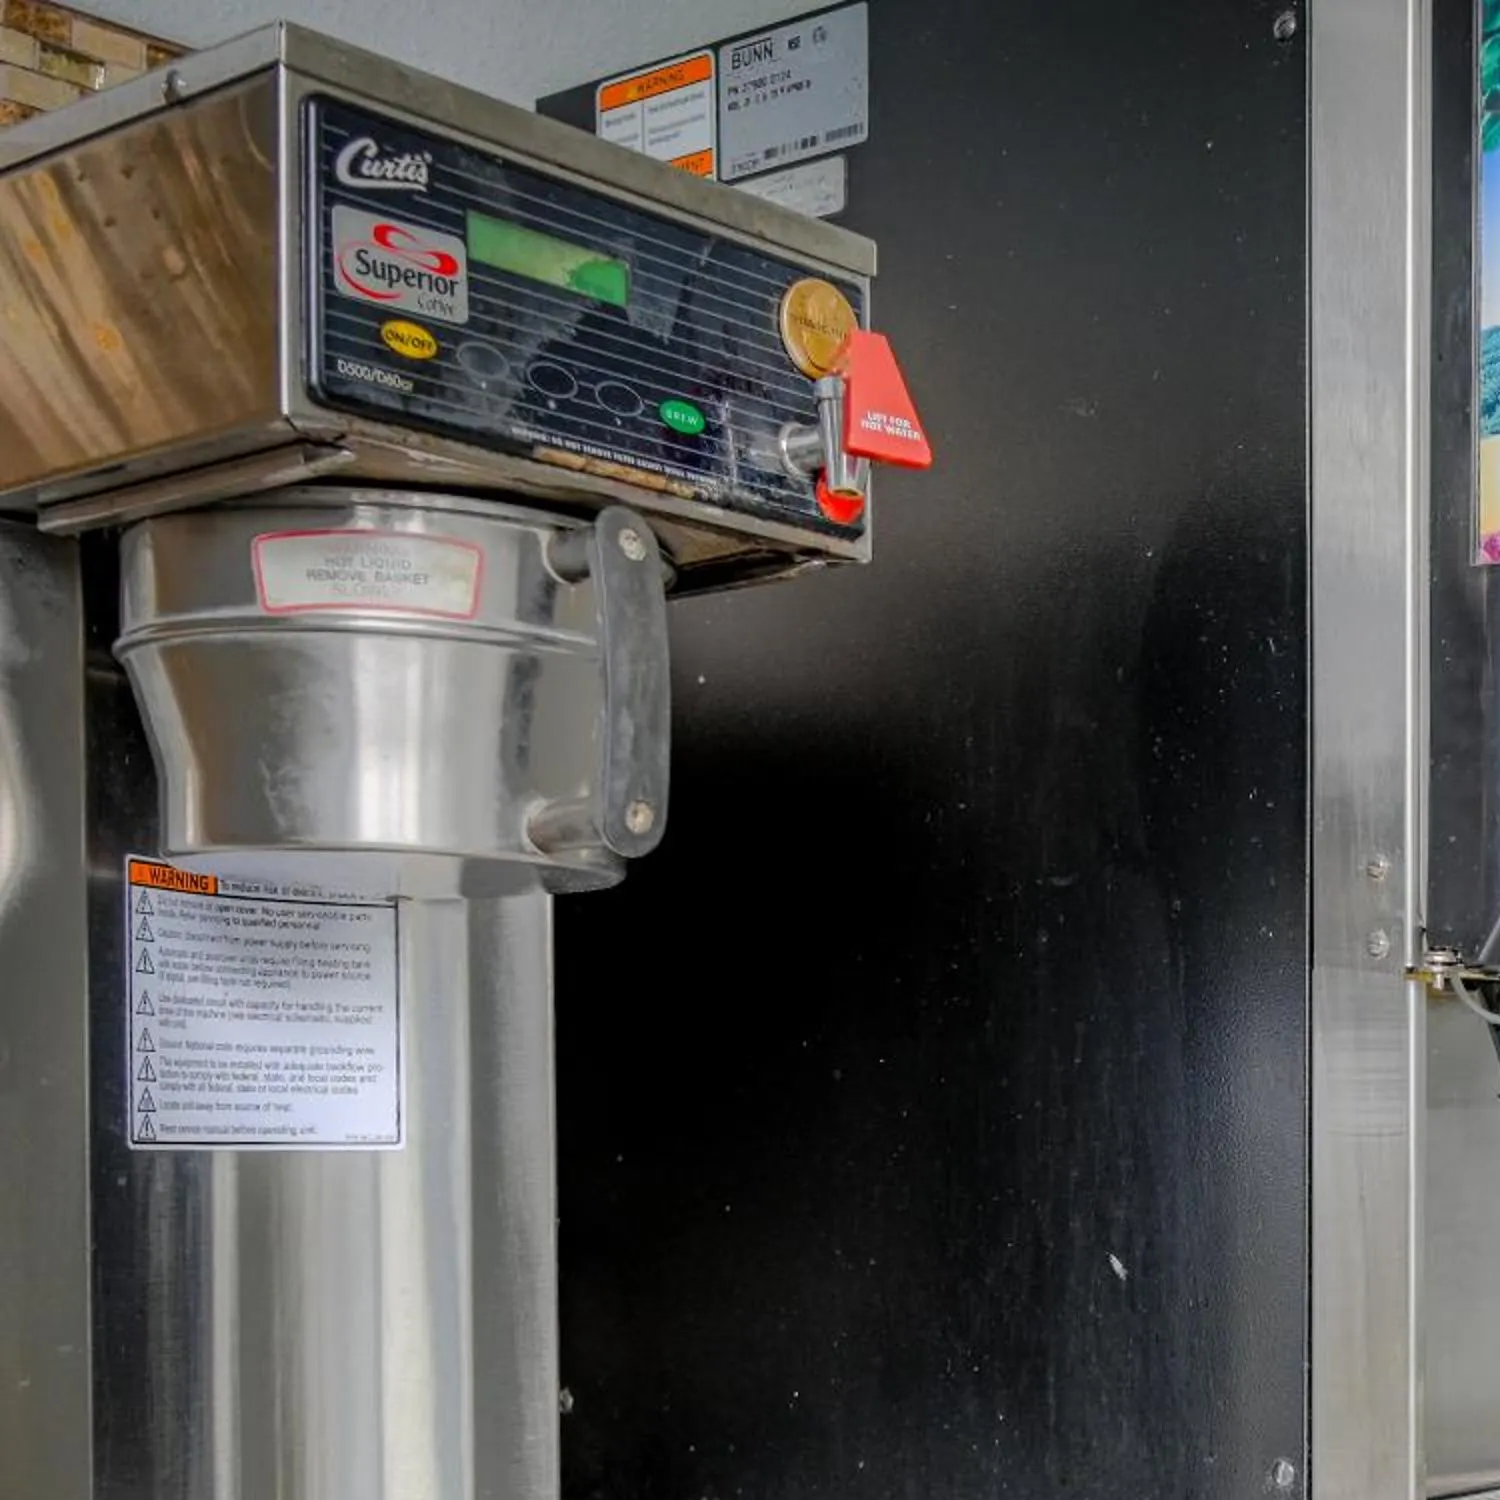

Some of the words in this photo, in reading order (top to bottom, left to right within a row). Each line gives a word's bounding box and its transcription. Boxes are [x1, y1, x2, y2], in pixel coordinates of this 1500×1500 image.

[731, 42, 774, 70] BUNN
[355, 249, 460, 297] Superior
[385, 329, 434, 350] ON/OFF
[667, 408, 699, 426] BREW
[884, 424, 921, 441] WATER
[324, 556, 353, 569] HOT
[361, 556, 411, 570] LIQUID
[306, 569, 366, 583] REMOVE
[374, 571, 430, 584] BASKET
[149, 867, 209, 891] WARNING
